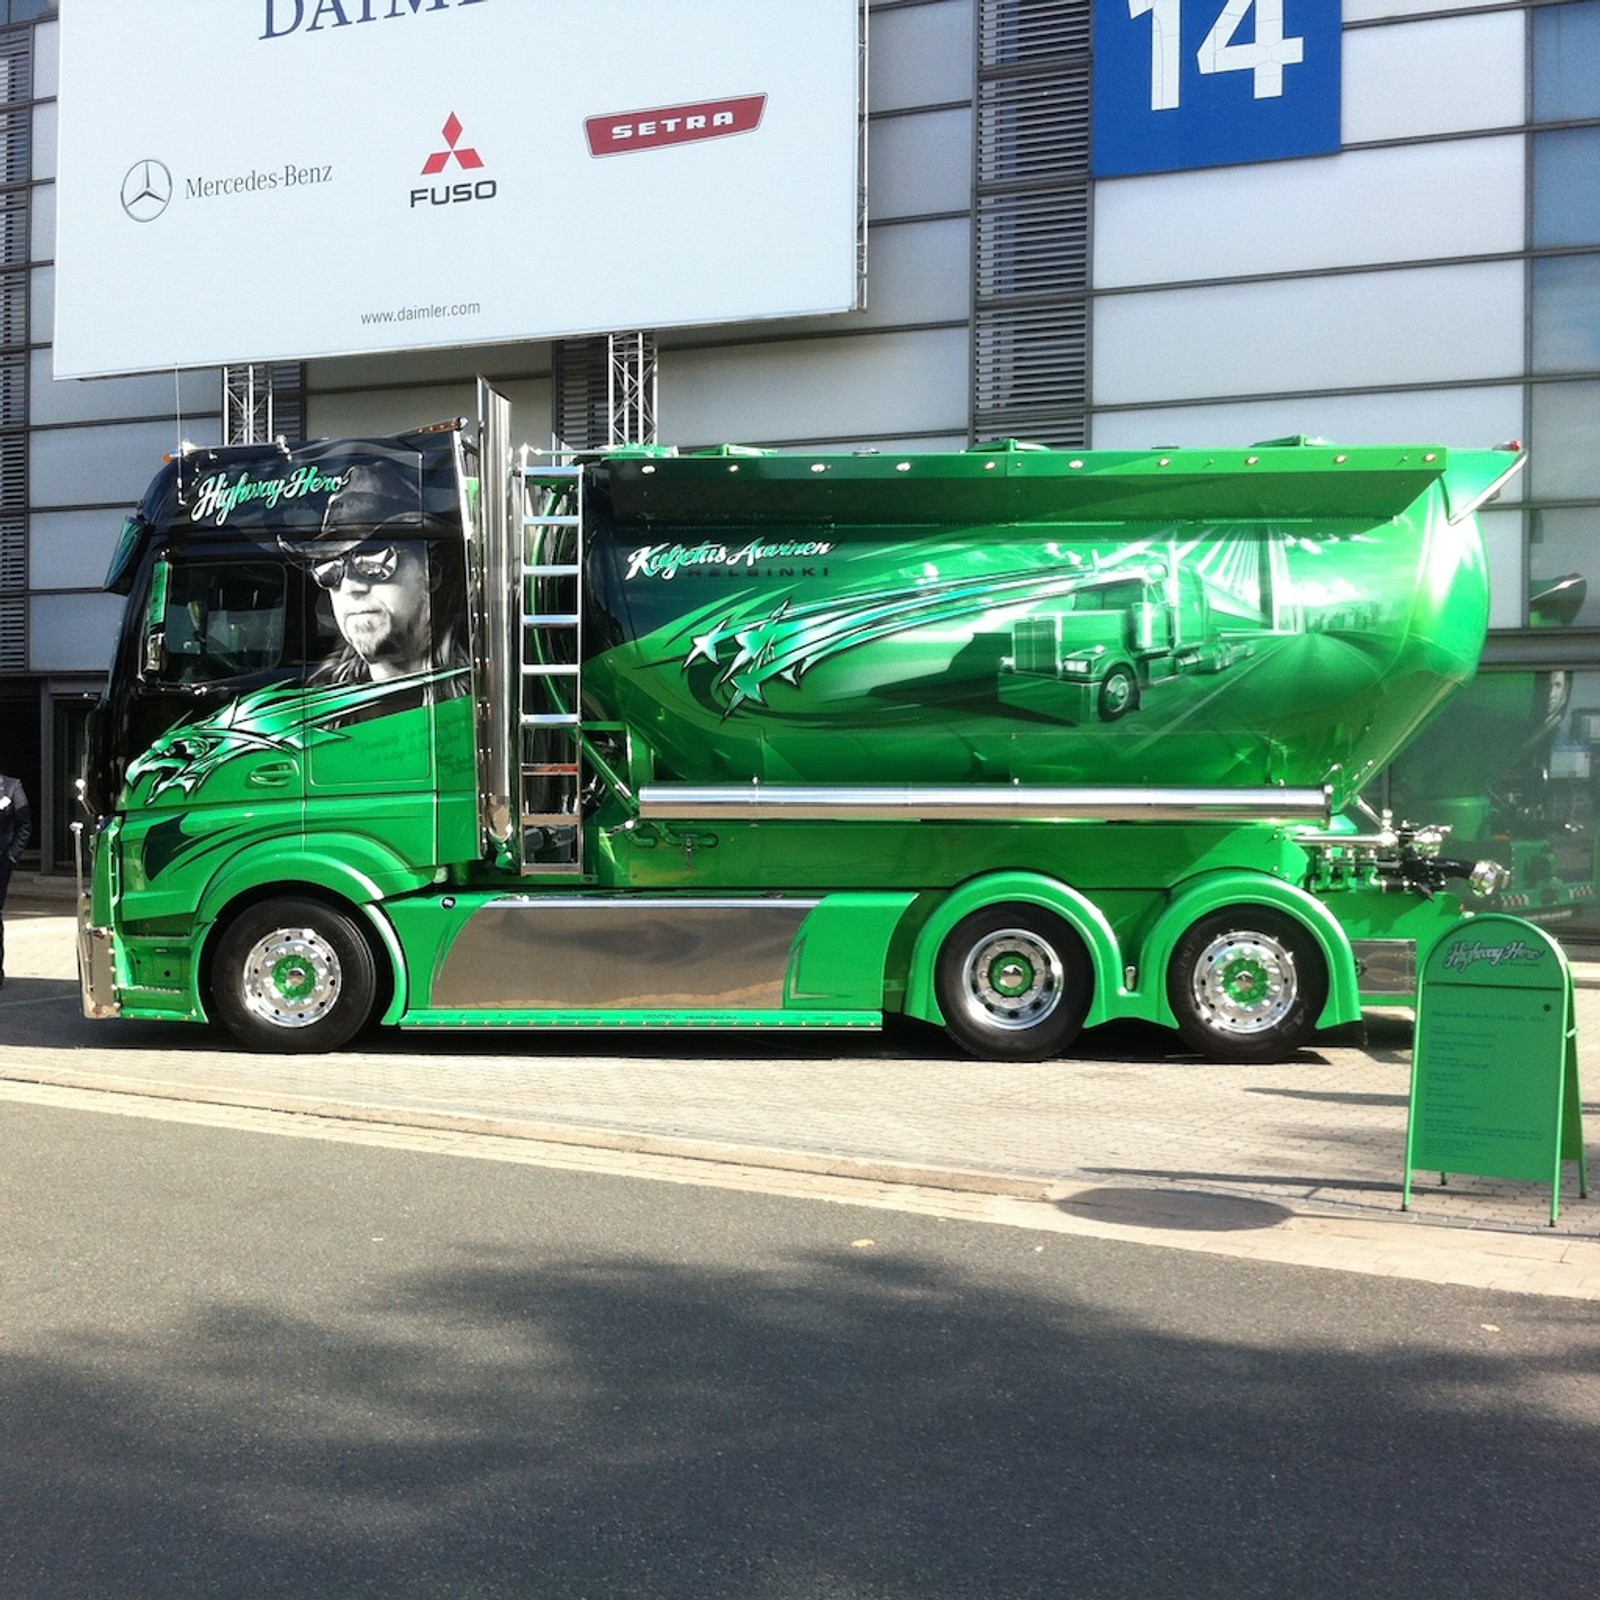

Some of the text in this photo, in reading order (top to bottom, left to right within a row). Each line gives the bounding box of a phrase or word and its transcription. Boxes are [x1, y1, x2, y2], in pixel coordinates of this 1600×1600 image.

[1129, 0, 1304, 111] 14
[611, 111, 734, 139] SETRA
[185, 164, 333, 199] Mercedes-Benz
[410, 180, 497, 207] FUSO
[361, 302, 481, 324] www.daimler.com
[191, 466, 349, 526] Highway Hero
